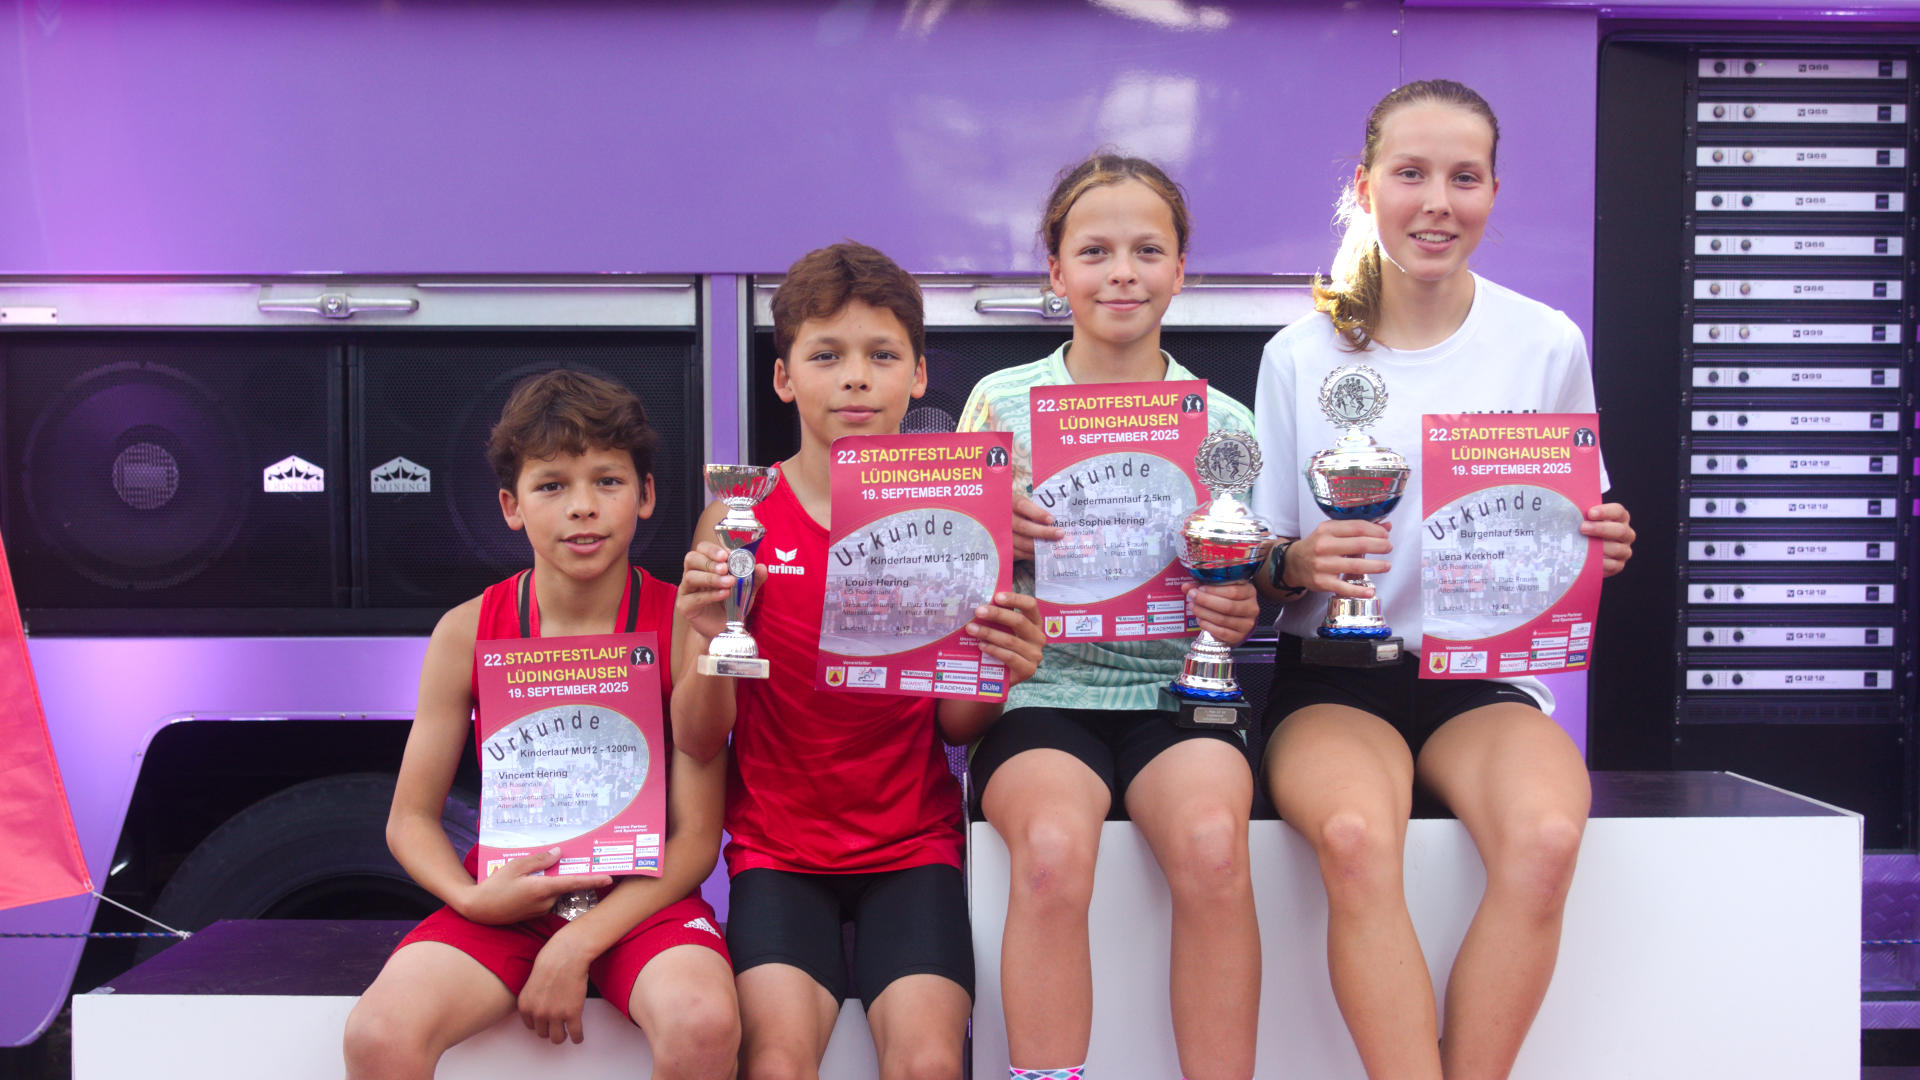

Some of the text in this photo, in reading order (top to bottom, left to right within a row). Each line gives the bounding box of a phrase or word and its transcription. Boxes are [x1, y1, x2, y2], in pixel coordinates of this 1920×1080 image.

[1059, 414, 1179, 430] LÜDINGHAUSEN
[1060, 429, 1179, 444] 19. SEPTEMBER 2025
[1451, 446, 1571, 460] LÜDINGHAUSEN
[861, 468, 983, 484] LÜDINGHAUSEN
[1452, 463, 1572, 475] 19. SEPTEMBER 2025
[373, 482, 429, 490] EMINENCE
[1038, 458, 1151, 508] Urkunde
[861, 484, 983, 500] 19. SEPTEMBER 2025
[1072, 494, 1141, 506] Jedermannlauf
[1079, 518, 1111, 527] Sophie
[1114, 517, 1145, 526] Hering
[1428, 490, 1542, 541] Urkunde
[835, 515, 953, 567] Urkunde
[1460, 529, 1513, 539] Burgenlauf
[870, 556, 922, 565] Kinderlauf
[924, 554, 950, 563] MU12
[960, 552, 989, 561] 1200m
[1438, 550, 1505, 561] Lena Kerkhoff
[768, 563, 805, 575] erima
[845, 578, 909, 587] Louis Hering
[507, 665, 628, 684] LÜDINGHAUSEN
[508, 681, 629, 699] 19. SEPTEMBER 2025
[488, 710, 600, 761] Urkunde
[520, 748, 569, 759] Kinderlauf
[571, 746, 597, 755] MU12
[607, 744, 637, 753] 1200m
[499, 769, 568, 780] Vincent Hering
